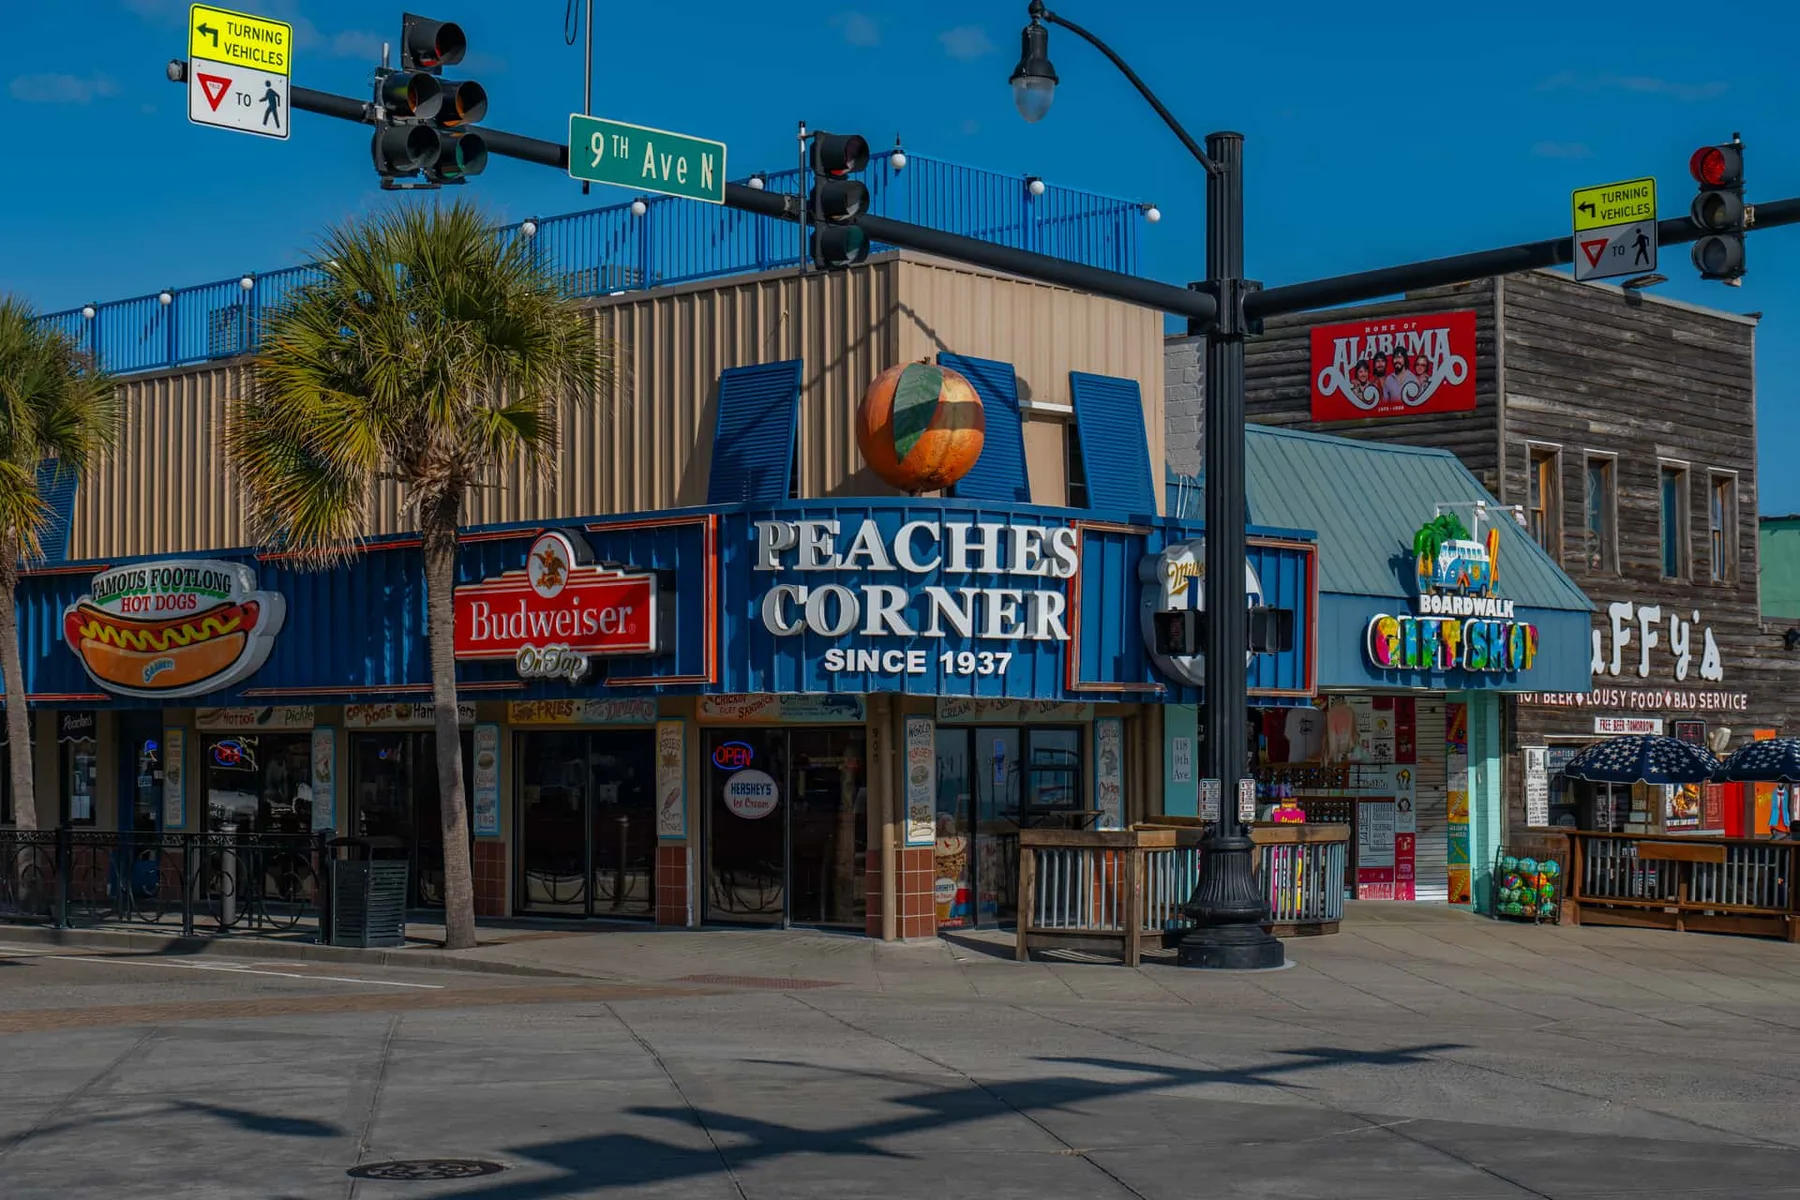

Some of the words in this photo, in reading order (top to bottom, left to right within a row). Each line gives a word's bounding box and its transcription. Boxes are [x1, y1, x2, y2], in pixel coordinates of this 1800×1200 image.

[227, 22, 283, 45] TURNING
[224, 42, 284, 66] VEHICLES
[236, 92, 252, 107] TO
[641, 142, 688, 184] Ave
[701, 152, 713, 191] N
[1600, 186, 1649, 205] TURNING
[1600, 203, 1651, 221] VEHICLES
[1612, 245, 1625, 256] TO
[1365, 324, 1396, 333] HOME
[1403, 322, 1418, 330] OF
[1317, 328, 1468, 410] ALABAMA
[753, 519, 1078, 578] PEACHES
[92, 568, 147, 601] FAMOUS
[150, 567, 232, 596] FOOTLONG
[1167, 560, 1207, 595] Mille
[121, 595, 151, 613] HOT
[156, 593, 197, 611] DOGS
[762, 583, 1071, 641] CORNER
[1420, 594, 1514, 618] BOARDWALK
[470, 596, 633, 641] Budweiser
[1367, 613, 1462, 670] GIFT
[1463, 616, 1540, 672] SHOP
[518, 646, 542, 671] On
[547, 645, 582, 677] Tap
[824, 649, 927, 674] SINCE
[939, 651, 1012, 675] 1937
[537, 700, 574, 720] FRIES
[1586, 688, 1627, 707] LOUSY
[1630, 691, 1662, 709] FOOD
[1674, 693, 1696, 709] BAD
[1700, 693, 1748, 710] SERVICE
[1600, 719, 1611, 732] FREE
[1613, 719, 1625, 732] BEER
[1627, 719, 1655, 732] TOMORROW
[714, 745, 751, 767] OPEN
[1175, 739, 1188, 751] 118
[1173, 770, 1191, 781] Ave.
[730, 782, 772, 796] HERSHEY'S
